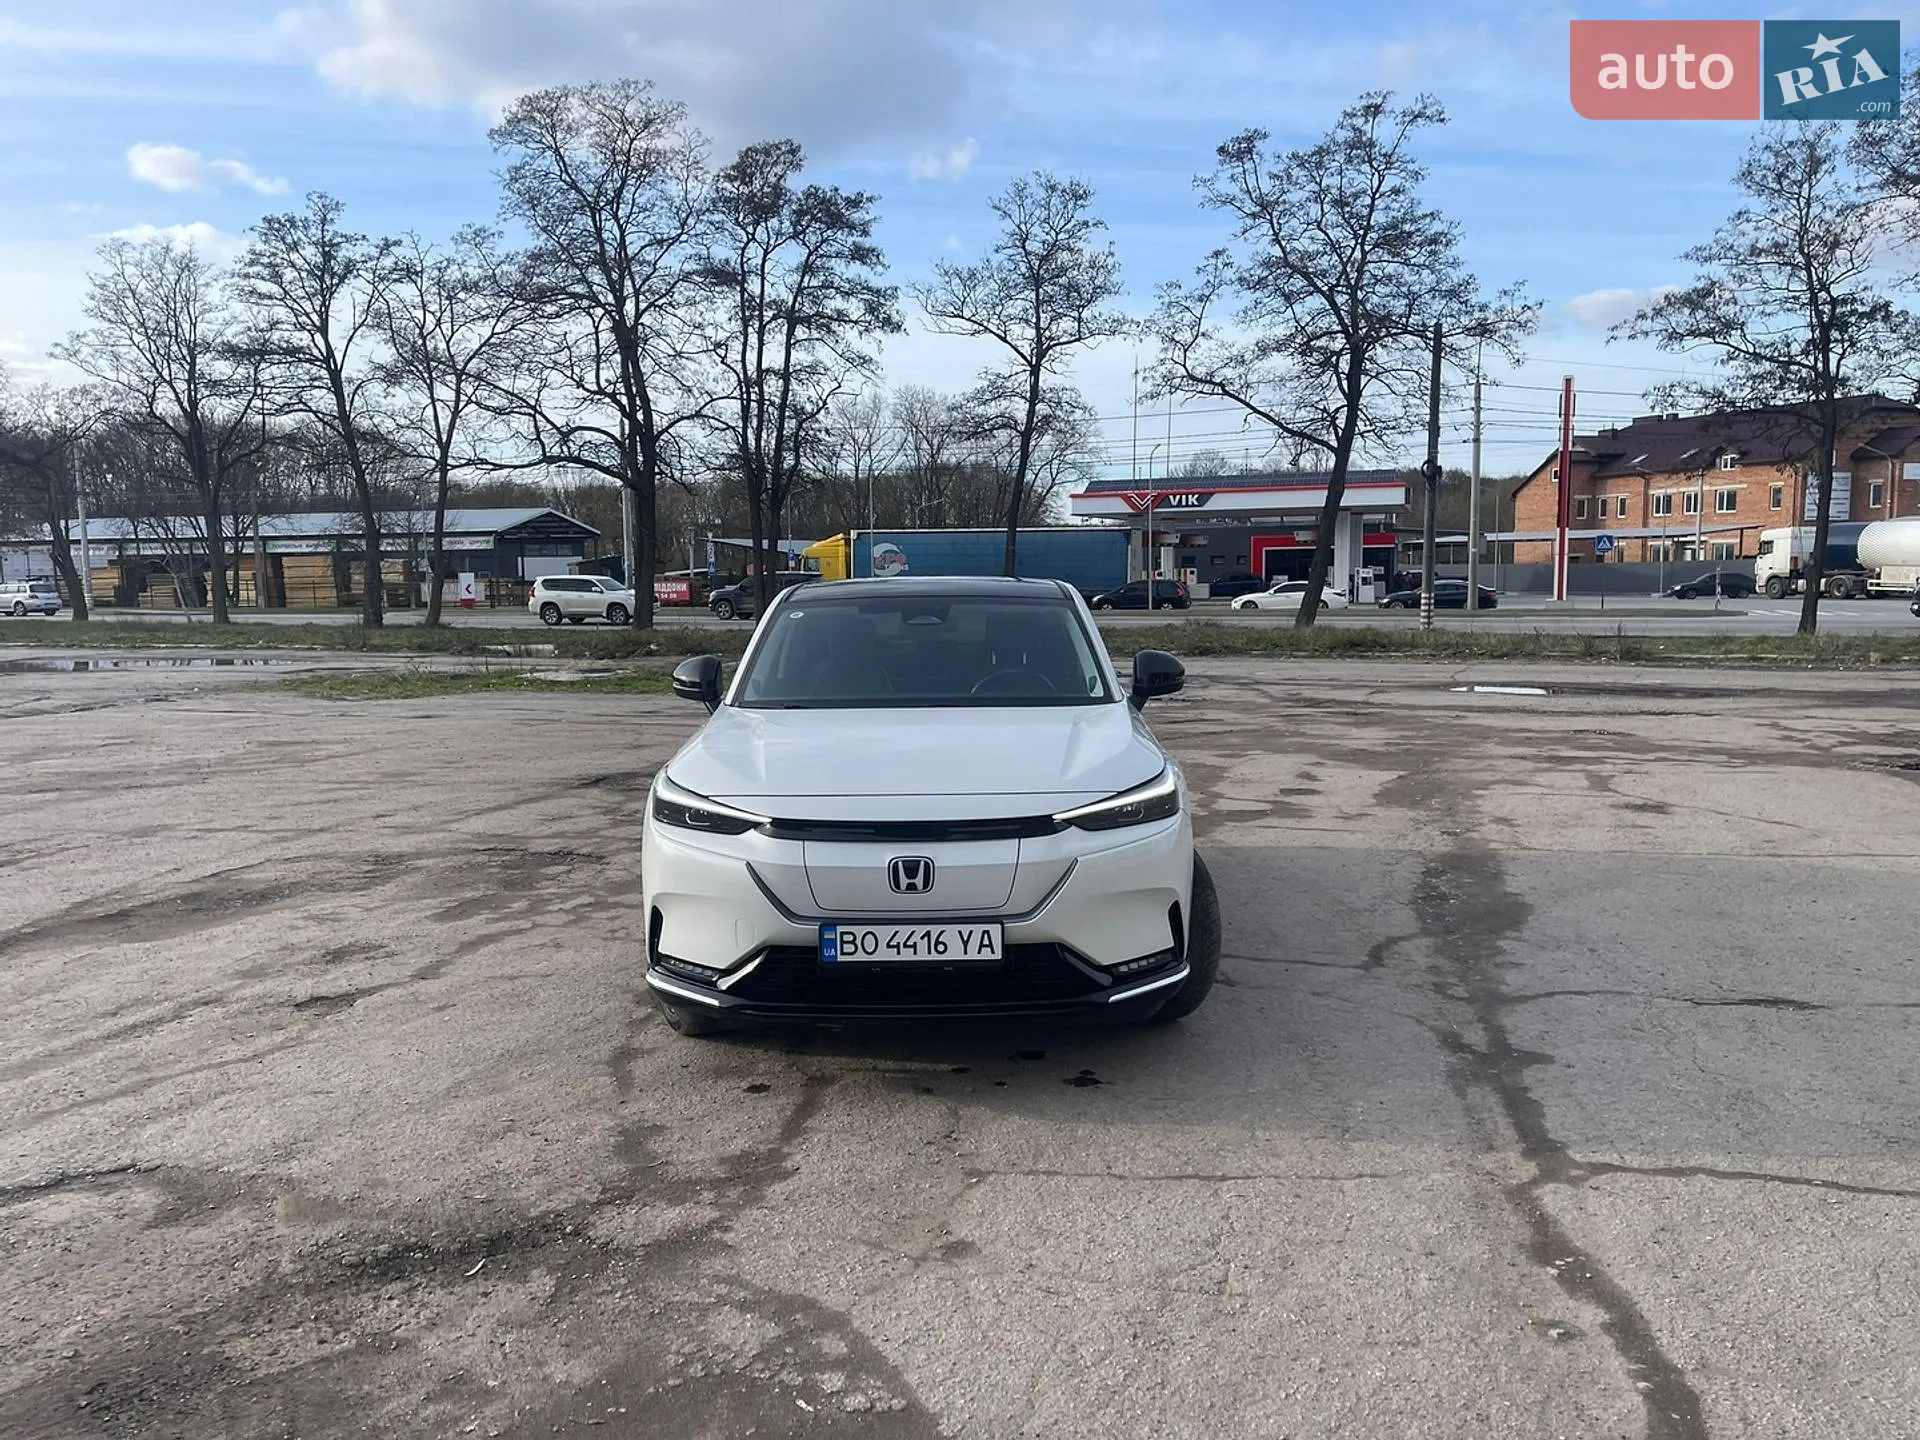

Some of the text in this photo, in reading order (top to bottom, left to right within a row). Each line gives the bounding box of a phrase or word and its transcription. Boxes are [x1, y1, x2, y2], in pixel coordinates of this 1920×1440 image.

[1168, 494, 1200, 506] VIK
[839, 929, 996, 956] BO 4416 YA
[823, 948, 836, 956] UA
